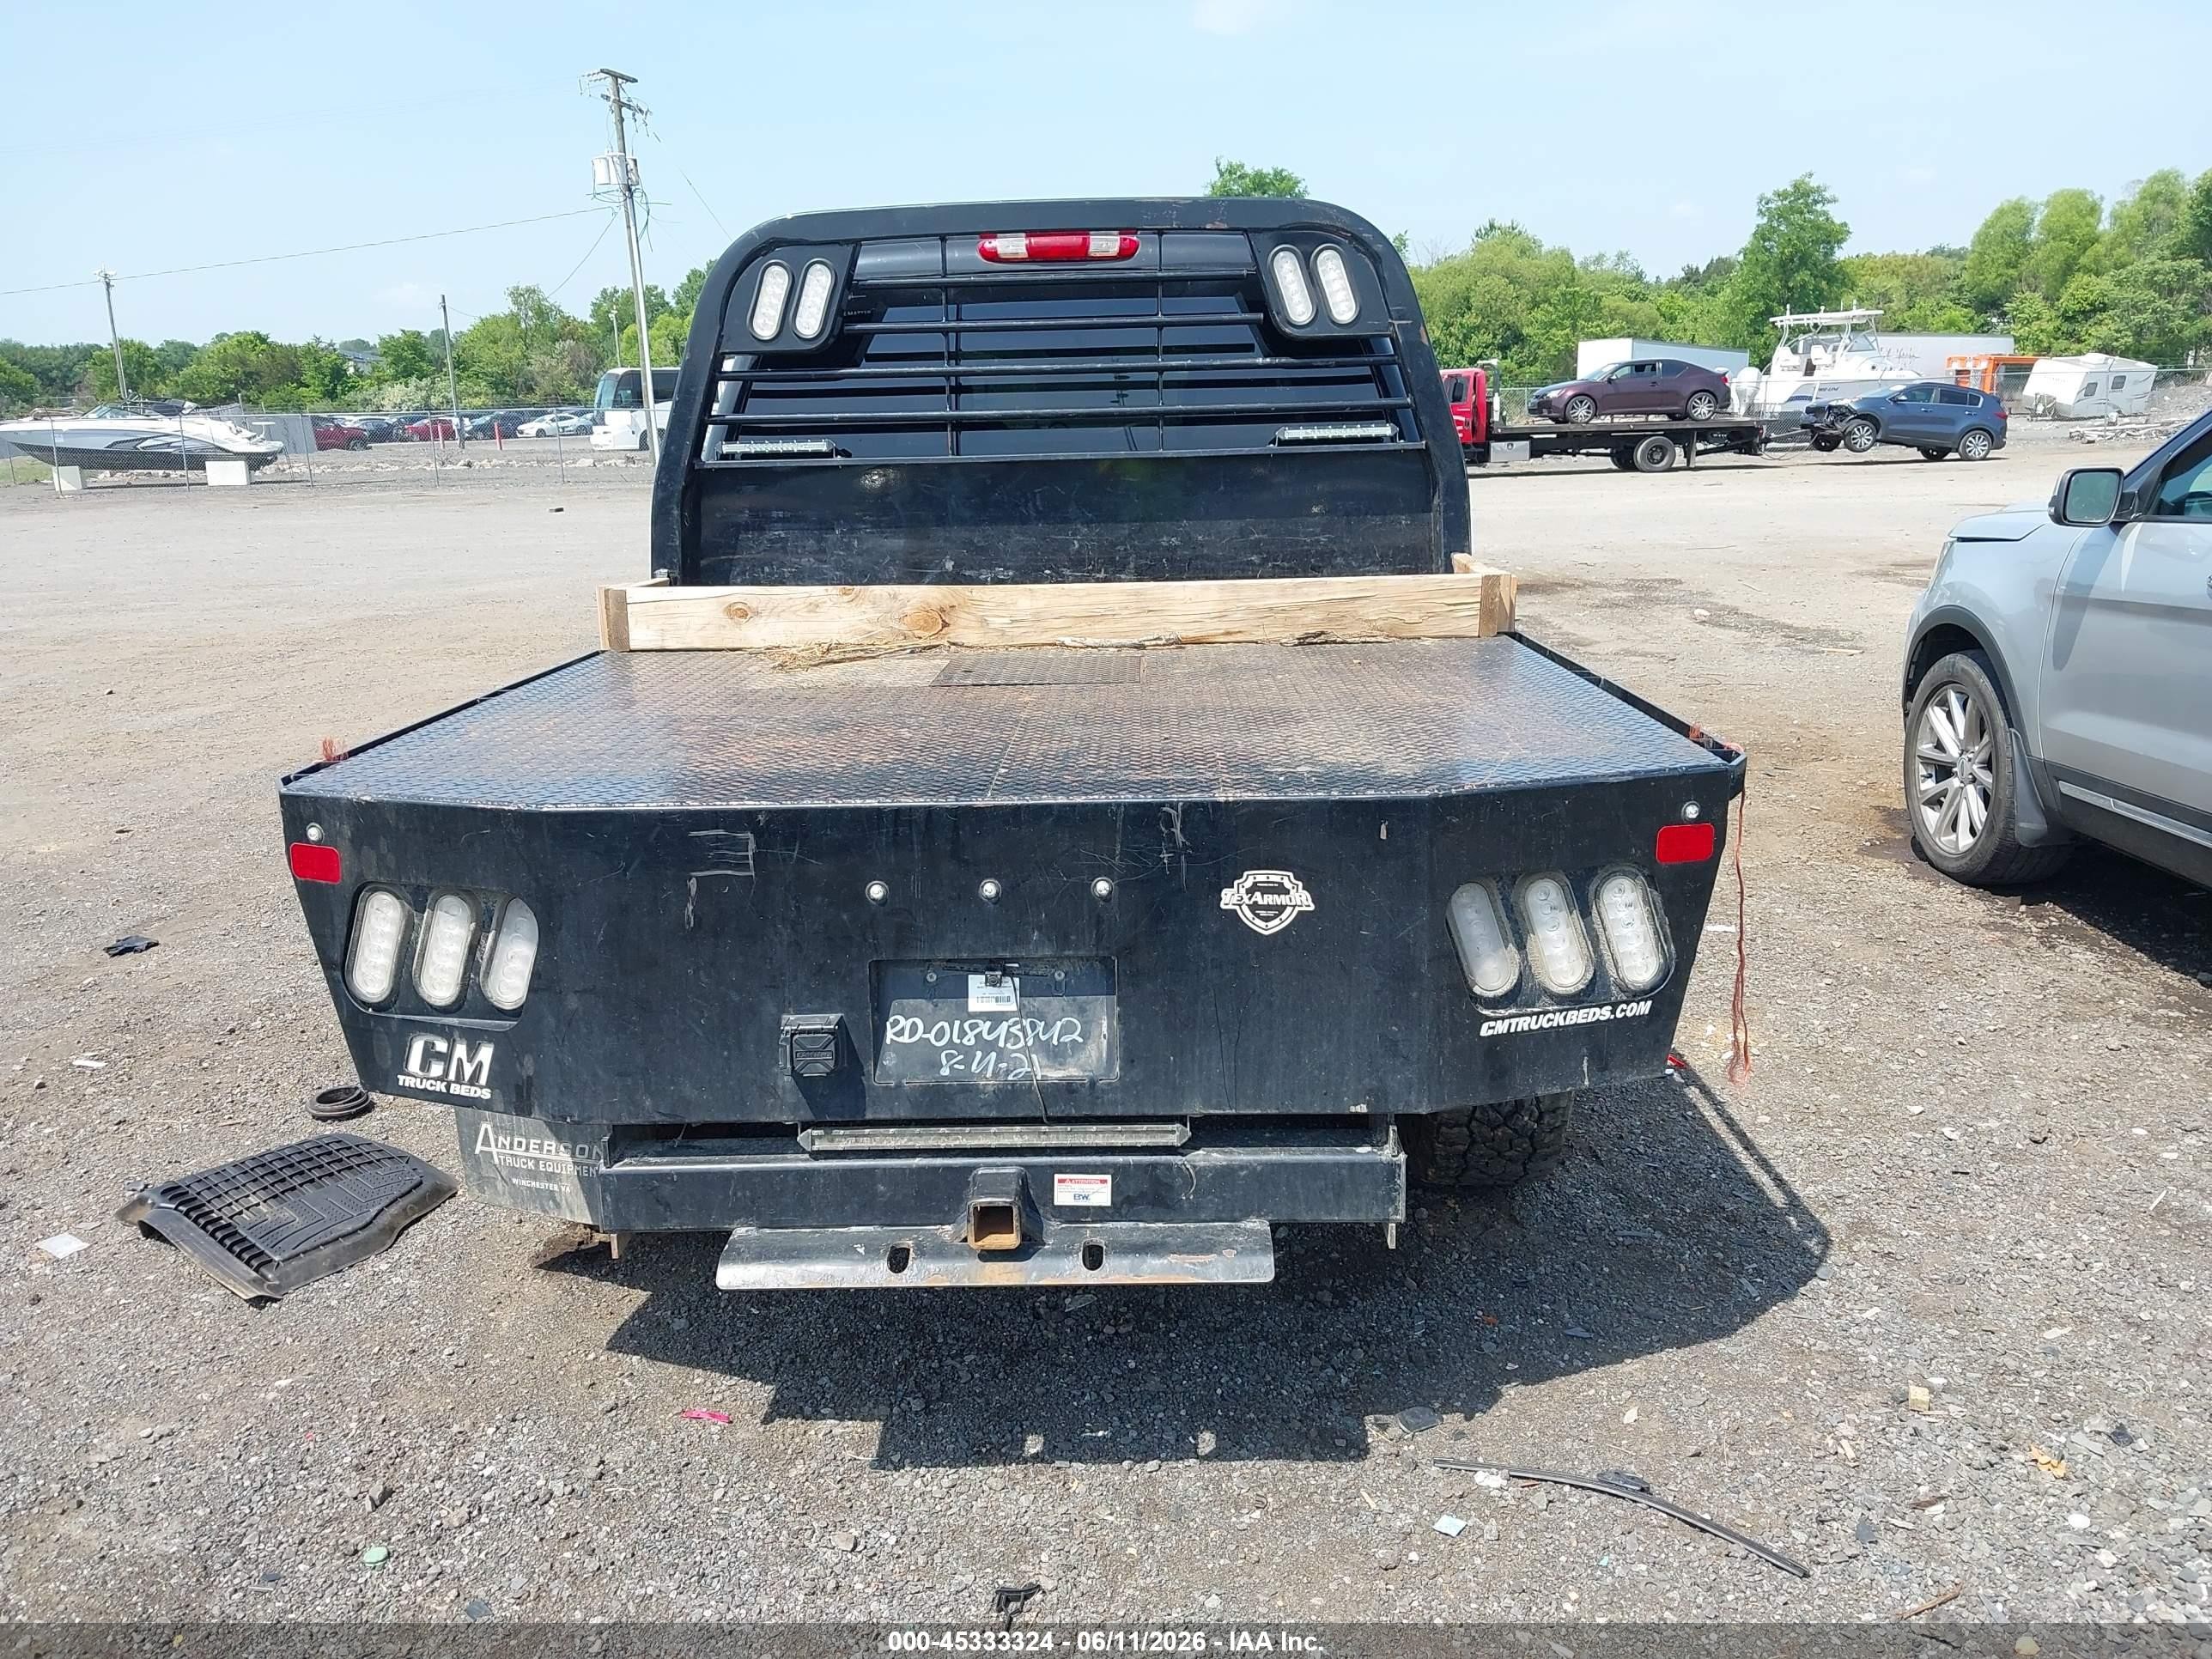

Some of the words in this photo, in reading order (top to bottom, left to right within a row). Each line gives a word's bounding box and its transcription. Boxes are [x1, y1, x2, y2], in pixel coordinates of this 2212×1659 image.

[1480, 1000, 1652, 1036] CMTRUCKBEDS.COM
[403, 1032, 495, 1086] CM
[397, 1074, 447, 1093] TRUCK
[449, 1082, 492, 1100] BEDS
[498, 1154, 535, 1170] TRUCK
[538, 1162, 599, 1178] EQUIPMEN
